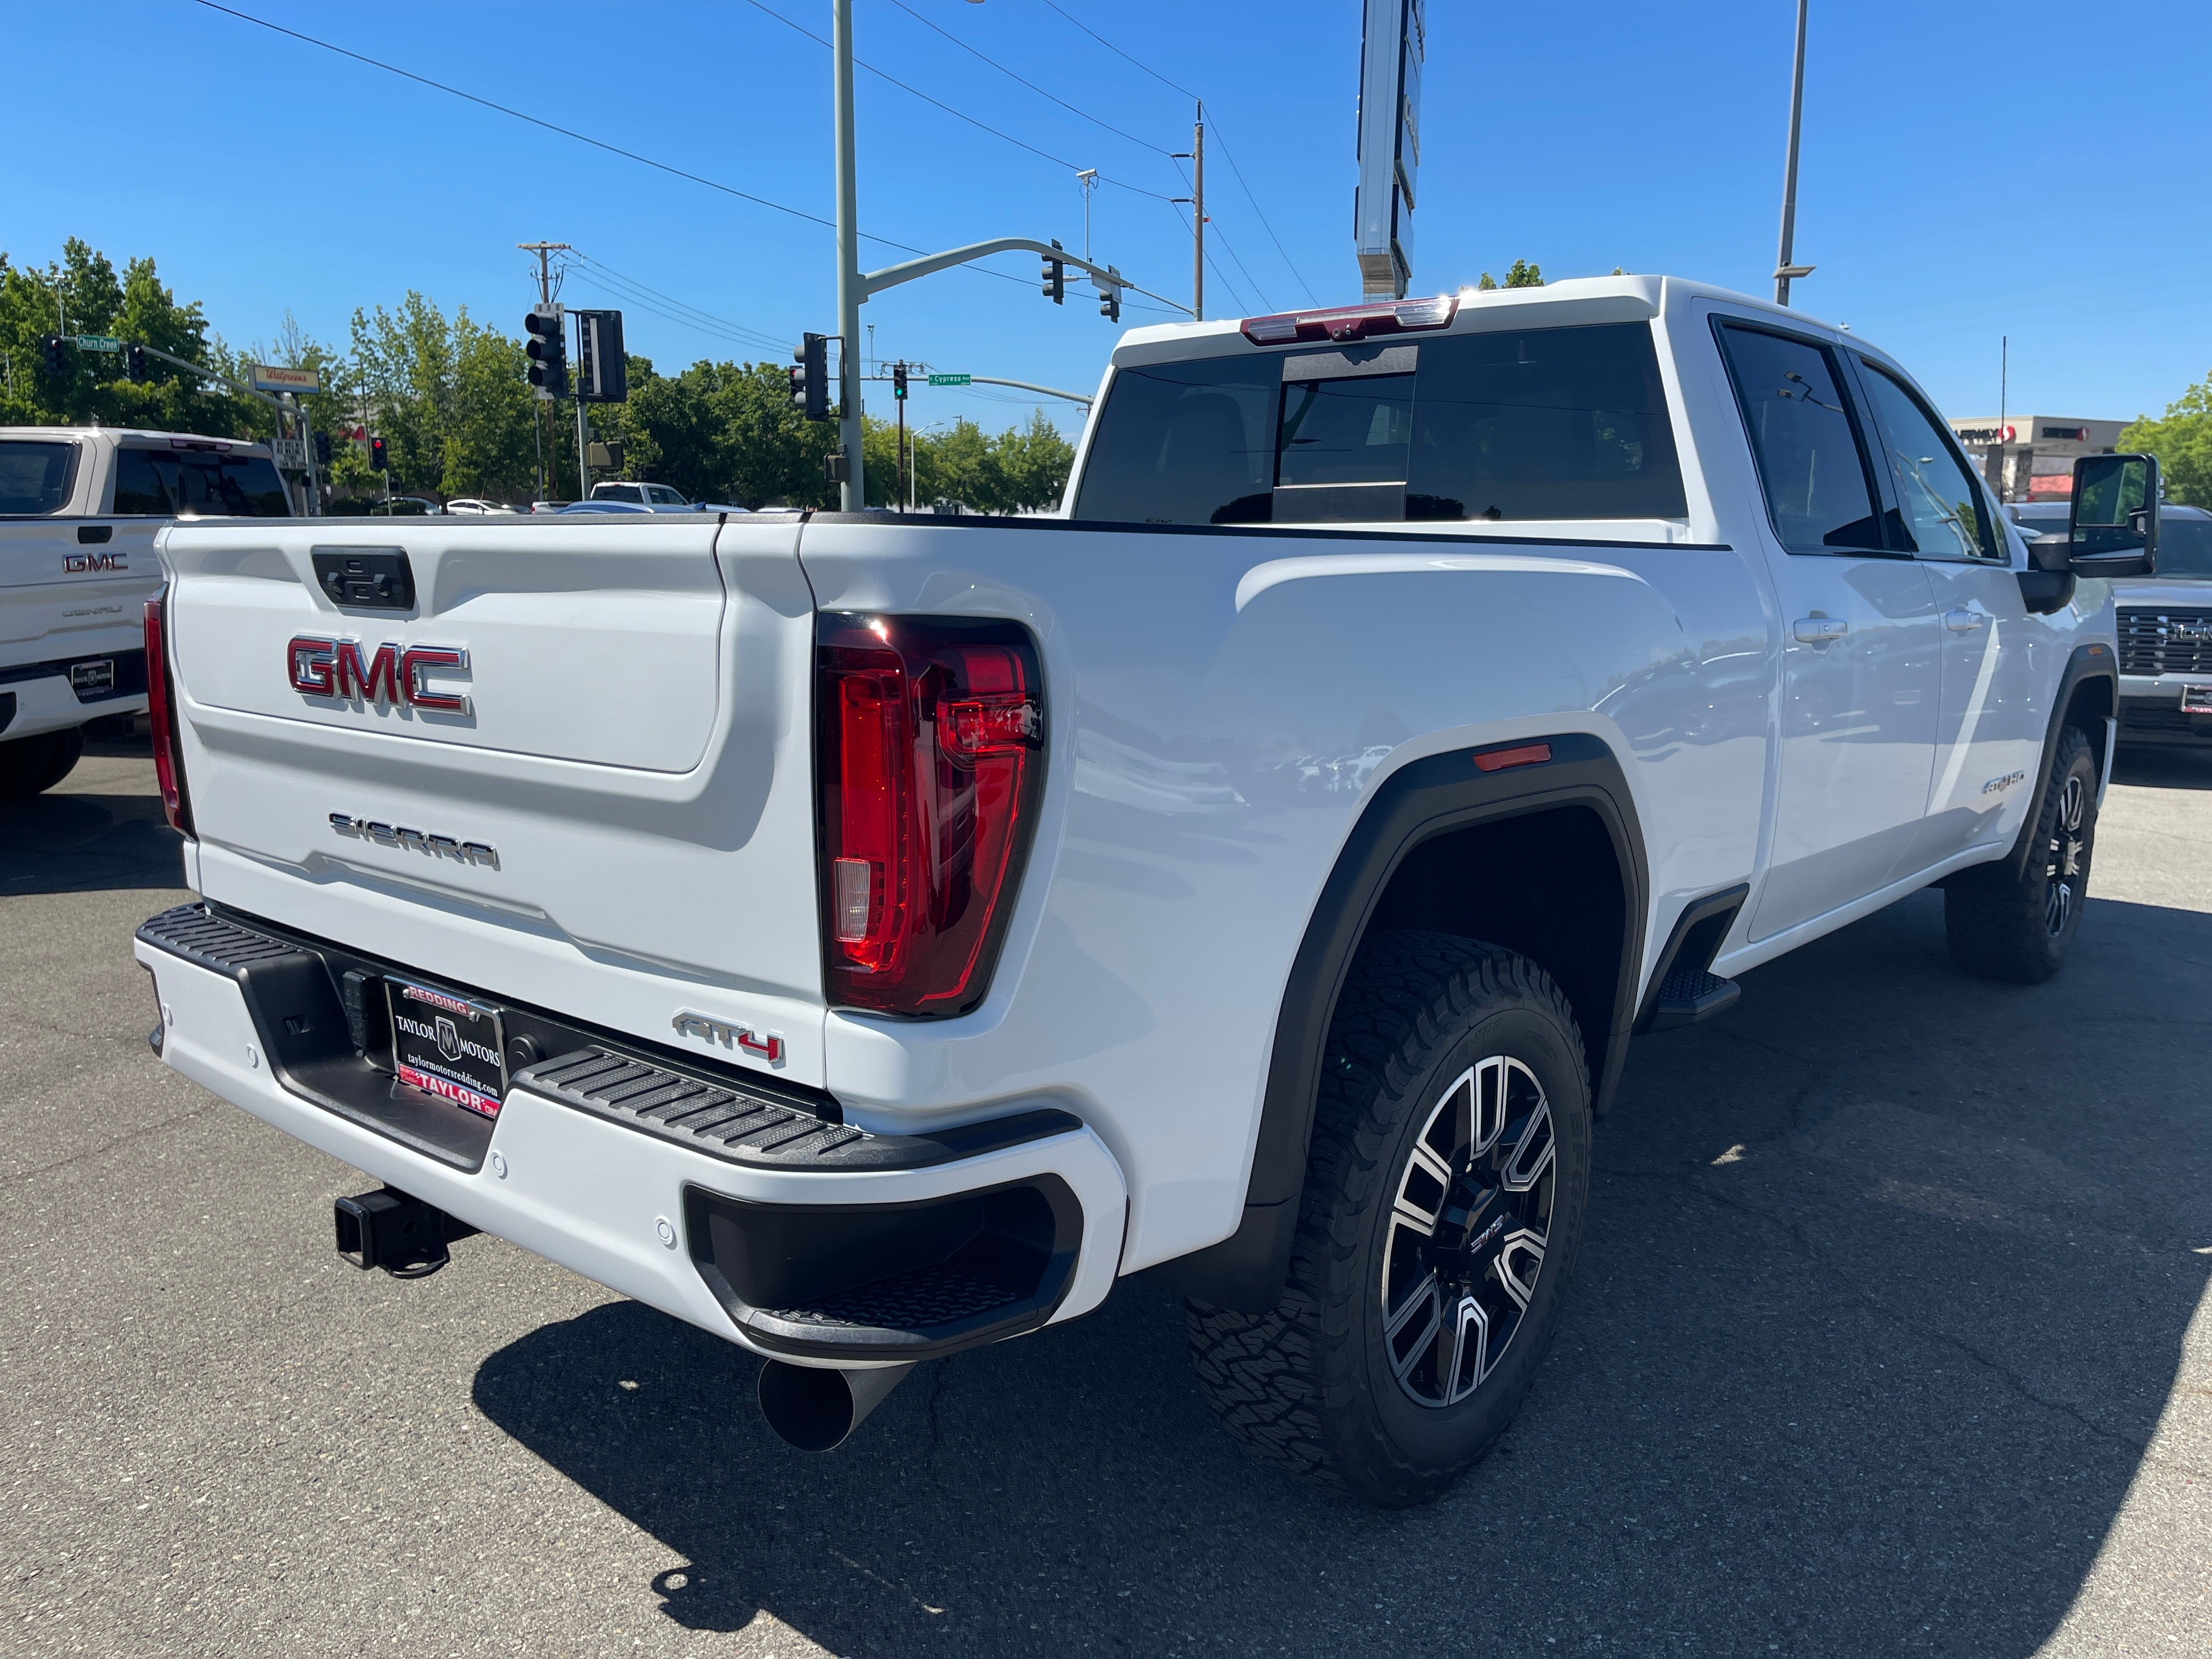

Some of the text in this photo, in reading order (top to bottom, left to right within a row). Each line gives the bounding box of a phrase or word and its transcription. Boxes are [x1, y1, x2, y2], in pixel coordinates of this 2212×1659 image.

[78, 337, 118, 350] Churn Creek
[266, 368, 308, 383] Walgreens
[934, 375, 961, 383] Cypress
[62, 550, 128, 573] GMC
[62, 606, 123, 617] DENALI
[287, 635, 472, 715] GMC
[329, 812, 498, 868] SIERRA
[409, 986, 467, 1015] REDDING
[396, 1015, 437, 1041] TAYLOR
[459, 1037, 500, 1067] MOTORS
[672, 1011, 783, 1064] AT4
[408, 1053, 498, 1097] taylormotorsredding.com
[420, 1073, 482, 1111] TAYLOR
[1470, 1214, 1504, 1254] GMC
